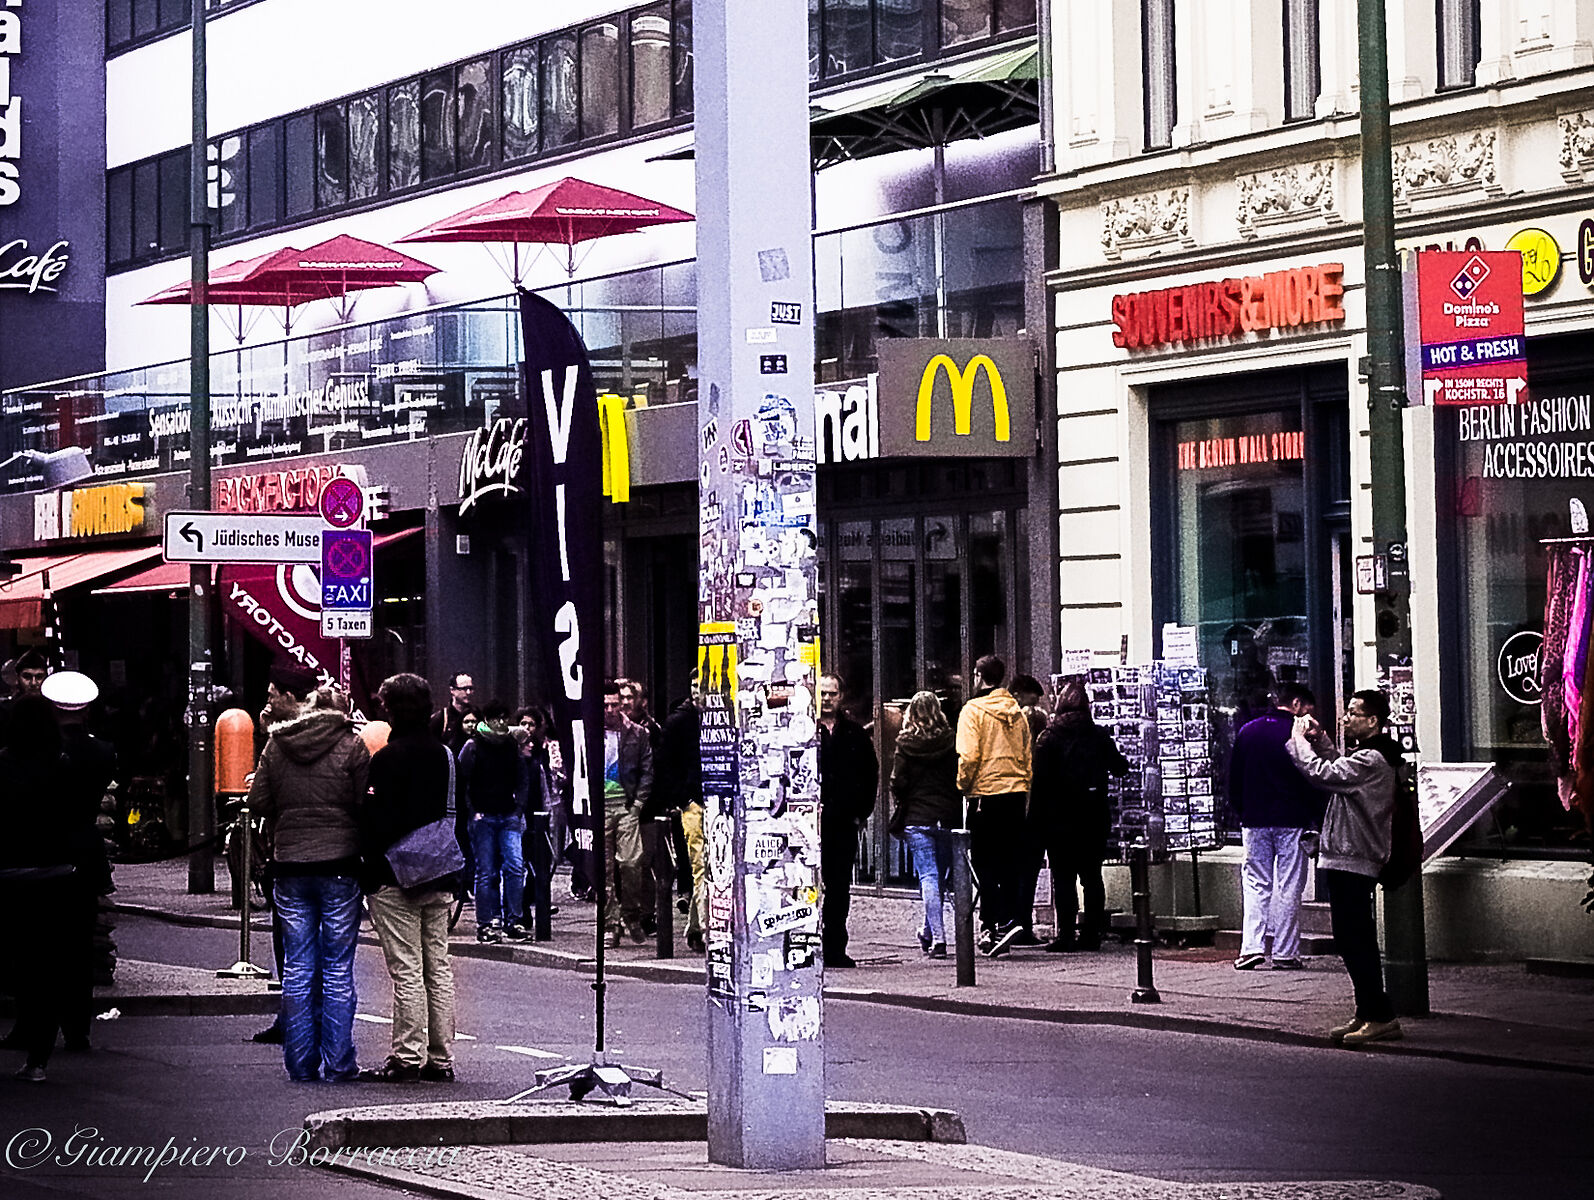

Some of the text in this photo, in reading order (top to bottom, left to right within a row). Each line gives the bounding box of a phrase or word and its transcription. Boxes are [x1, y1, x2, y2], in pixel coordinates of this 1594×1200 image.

[772, 303, 800, 320] JUST
[1112, 278, 1242, 348] SOUVENIRS
[1264, 263, 1345, 328] MORE
[1443, 300, 1500, 316] Domino's
[1456, 315, 1490, 327] Pizza
[1430, 339, 1520, 364] HOT & FRESH
[1444, 379, 1454, 388] IN
[1475, 378, 1504, 388] RECHTS
[1445, 388, 1505, 400] KOCHSTR. 16
[1459, 395, 1591, 442] BERLIN FASHION
[1178, 440, 1196, 470] THE
[1239, 433, 1269, 464] WALL
[1483, 441, 1594, 478] ACCESSOIRES
[212, 529, 280, 547] Jüdisches
[327, 617, 366, 630] 5 Taxen
